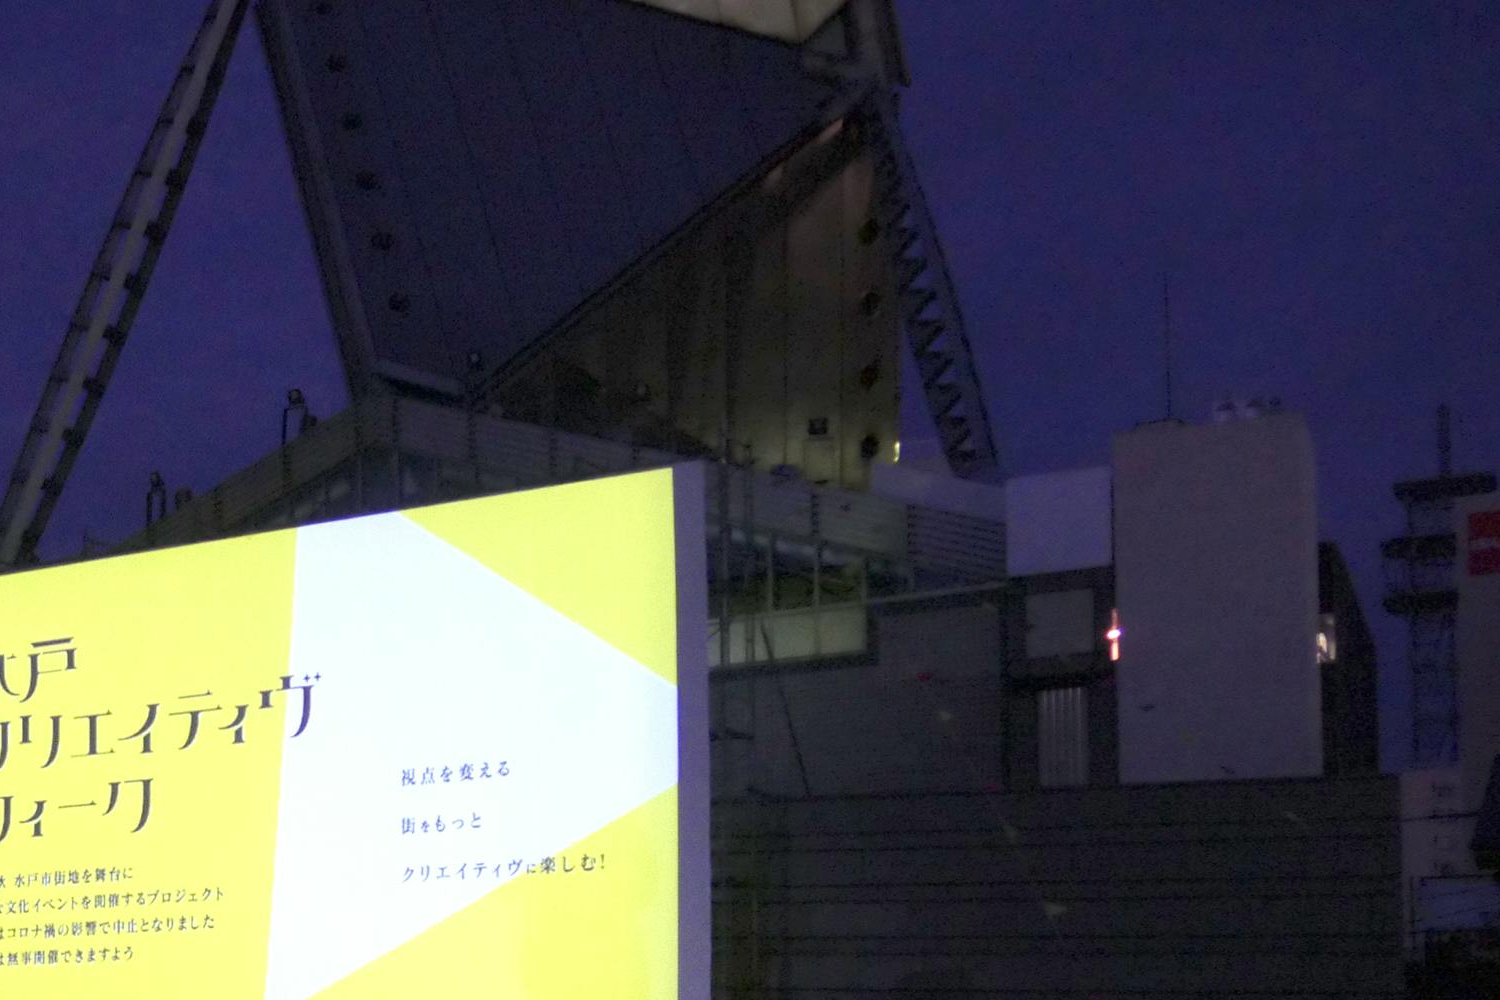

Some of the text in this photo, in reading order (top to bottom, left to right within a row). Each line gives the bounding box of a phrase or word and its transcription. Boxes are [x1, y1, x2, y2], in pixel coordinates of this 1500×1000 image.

[401, 760, 511, 787] 視点を変える
[401, 811, 482, 835] 街をもっと
